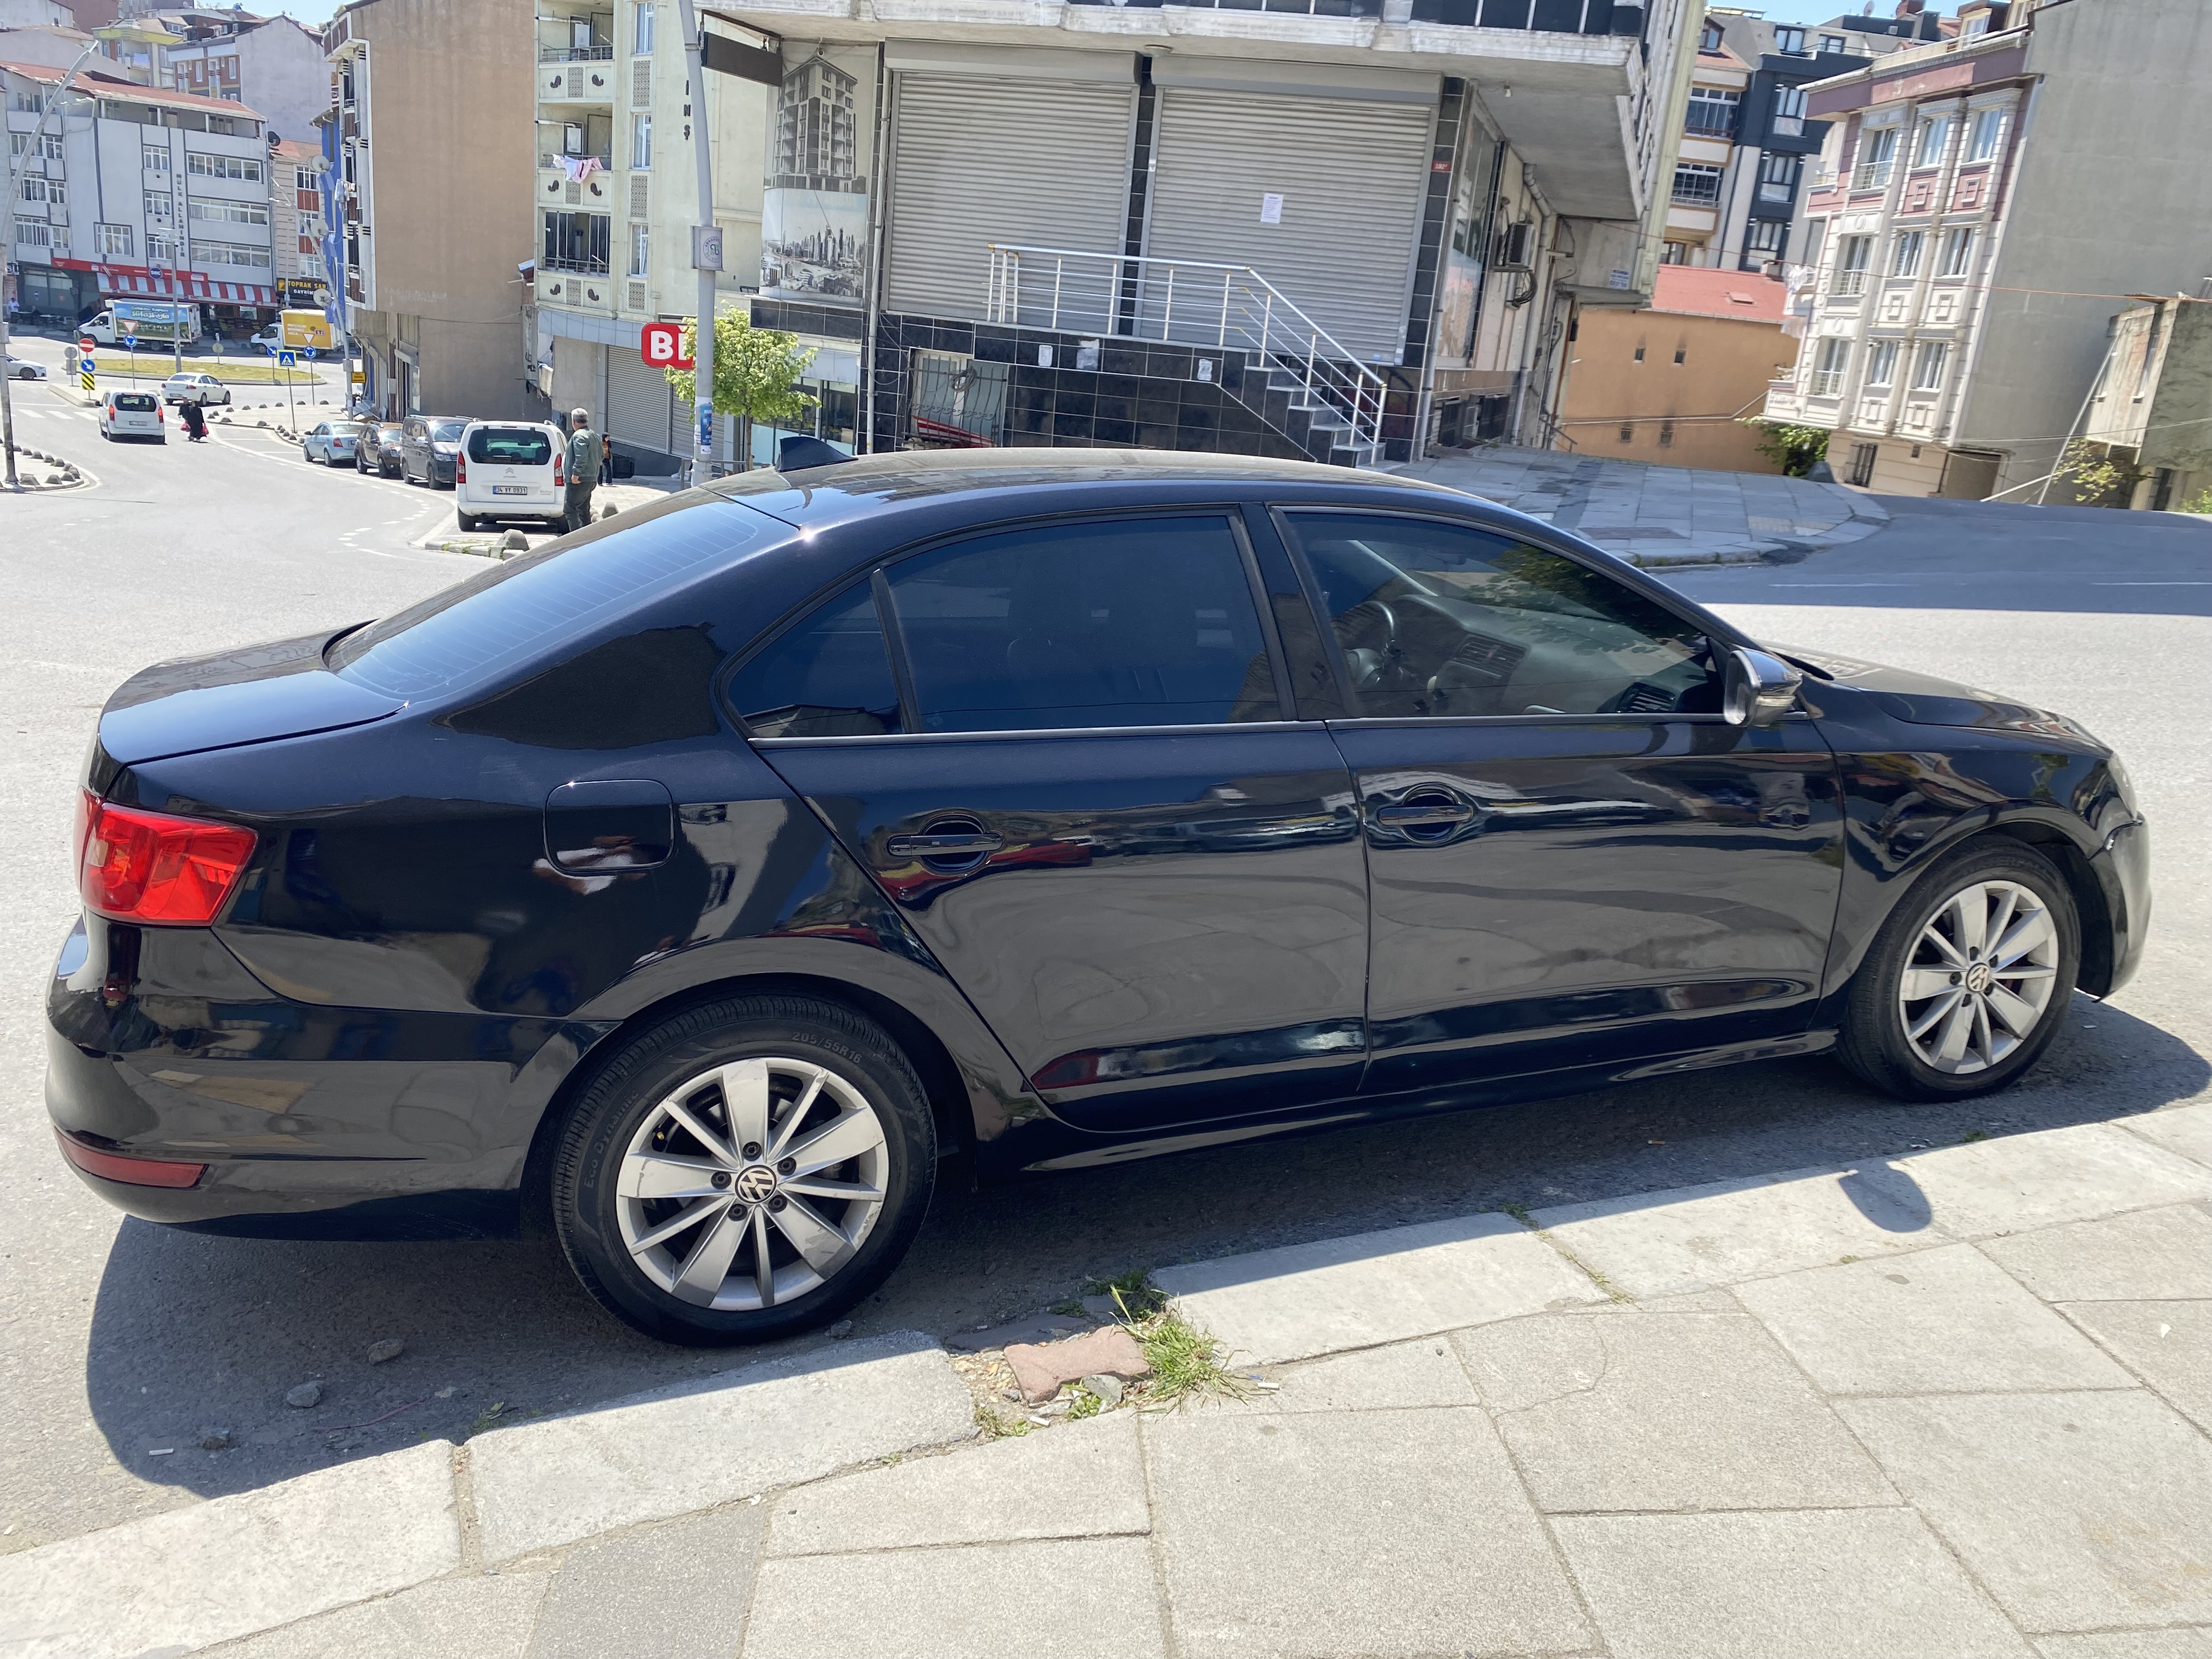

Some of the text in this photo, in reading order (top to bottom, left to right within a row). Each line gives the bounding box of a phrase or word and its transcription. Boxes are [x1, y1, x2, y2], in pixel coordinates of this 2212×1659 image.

[288, 280, 312, 289] TOPRAK
[792, 1031, 862, 1064] 205/55R16
[583, 1089, 639, 1189] Eco Dynamic
